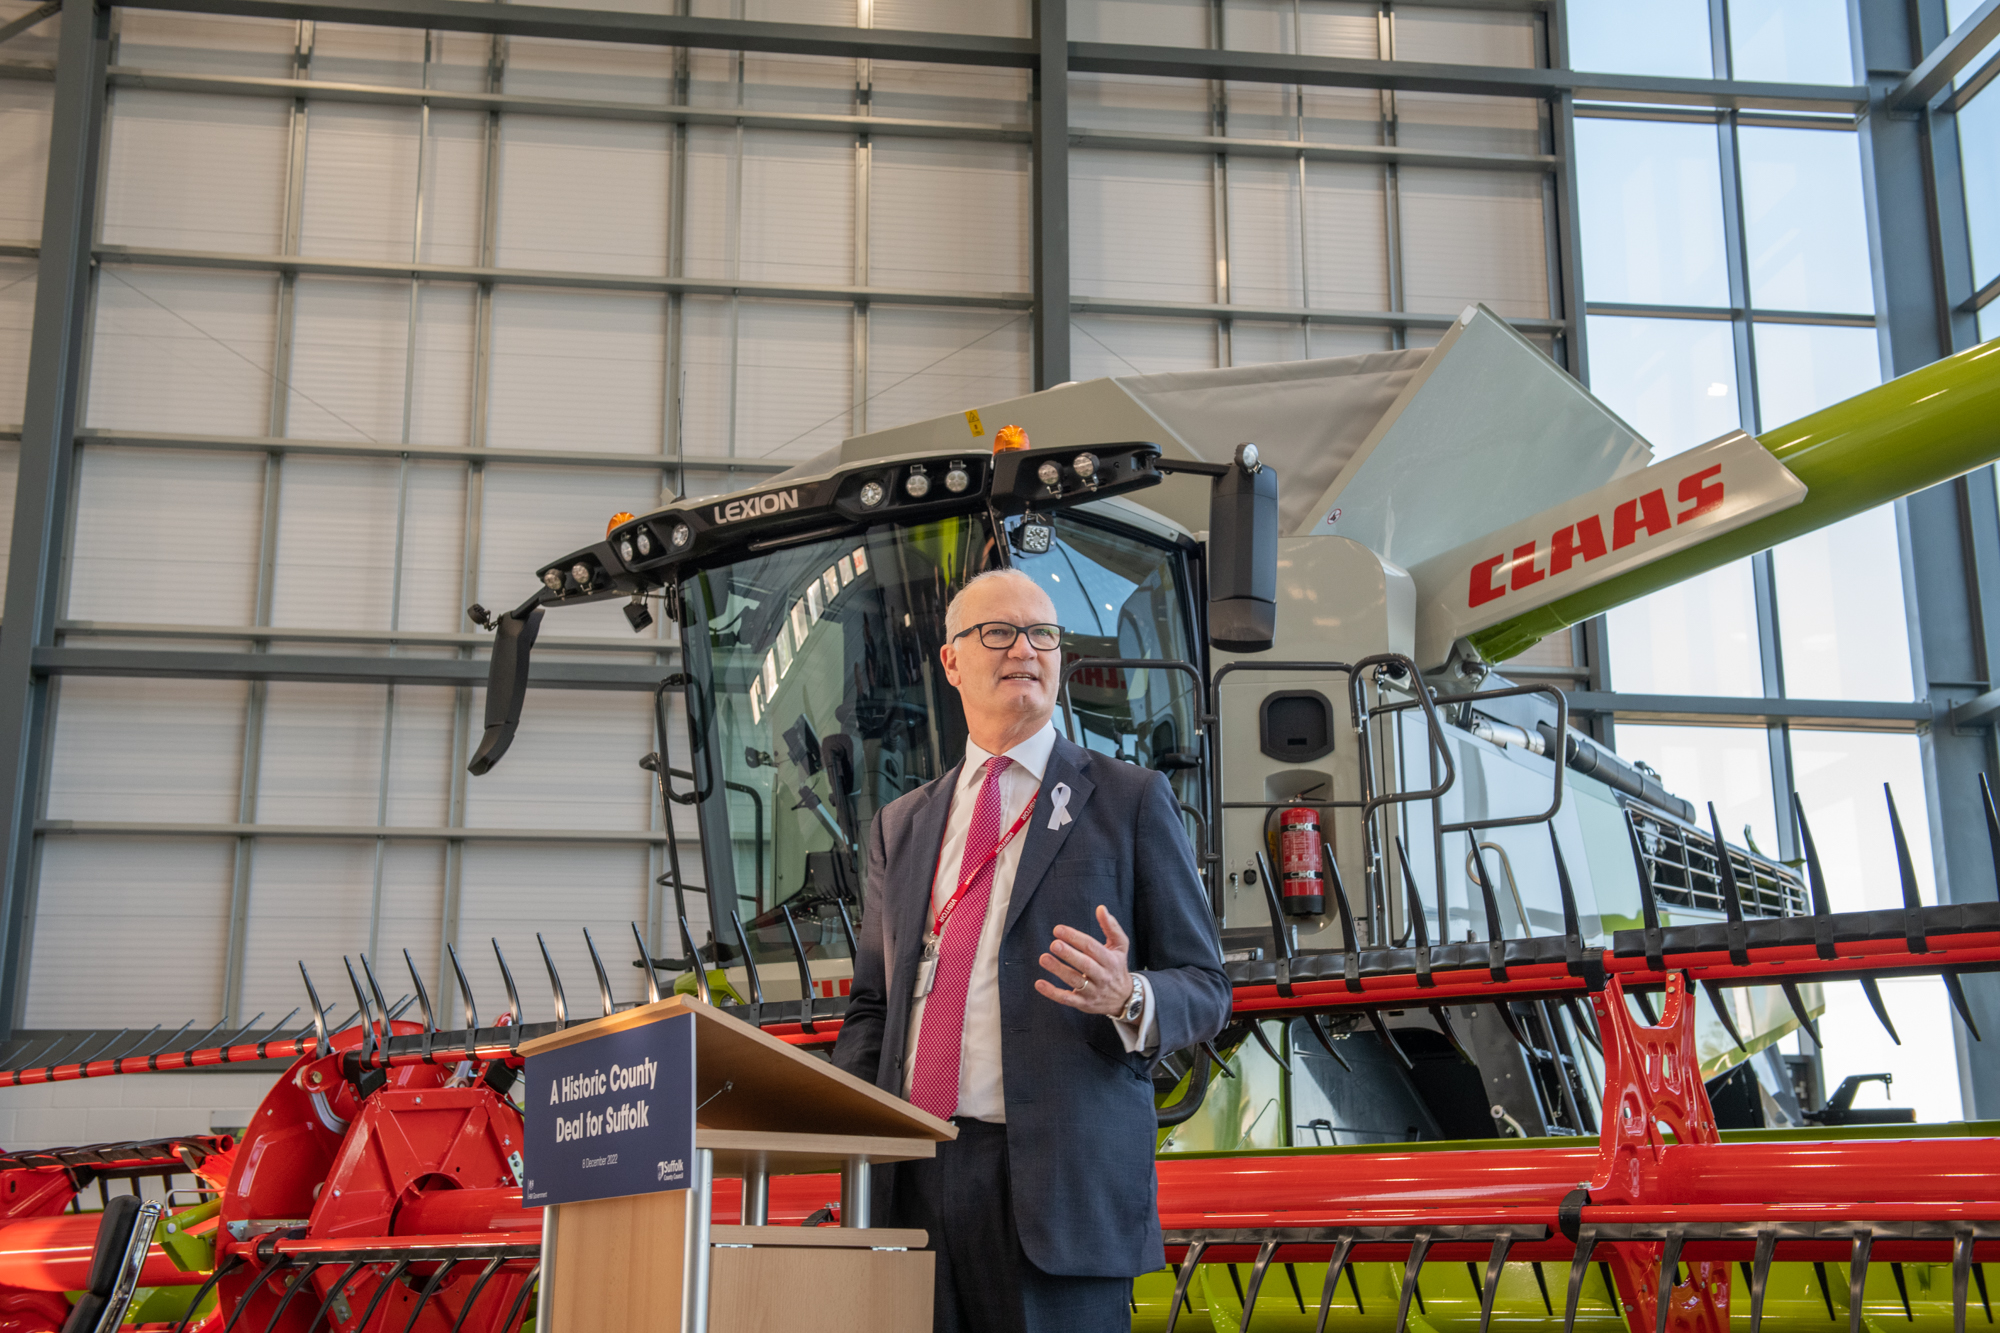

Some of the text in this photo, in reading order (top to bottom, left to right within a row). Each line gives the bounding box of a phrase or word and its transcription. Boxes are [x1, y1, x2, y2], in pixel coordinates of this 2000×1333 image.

[714, 489, 799, 525] LEXION
[1468, 463, 1724, 608] CLAAS
[994, 831, 1014, 854] VISITOR
[938, 898, 958, 923] VISITOR
[550, 1056, 658, 1106] A Historic County
[556, 1099, 650, 1143] Deal for Suffolk
[586, 1156, 607, 1168] December
[607, 1153, 618, 1165] 2022
[664, 1158, 684, 1173] Suffolk
[663, 1172, 684, 1182] County Council
